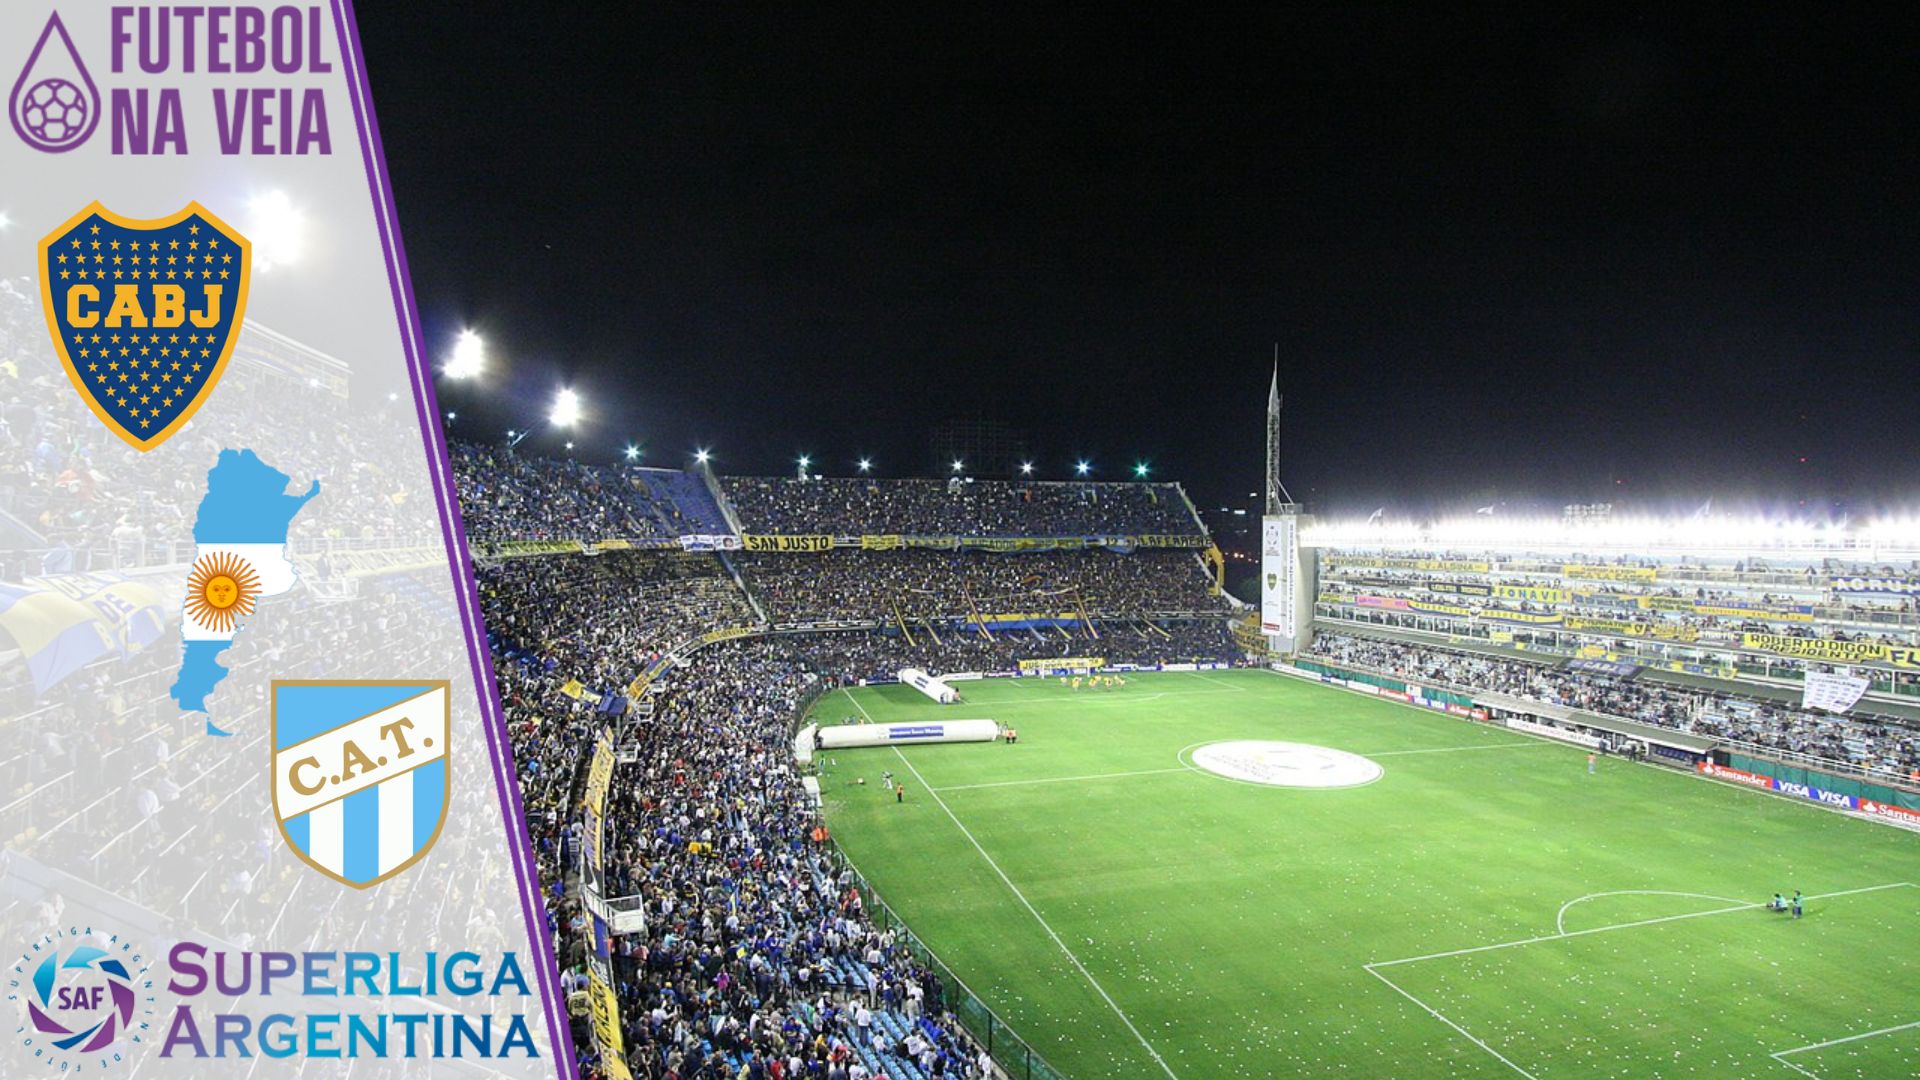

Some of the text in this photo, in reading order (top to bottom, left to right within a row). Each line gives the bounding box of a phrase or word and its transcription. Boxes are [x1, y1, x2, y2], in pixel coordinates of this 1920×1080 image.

[749, 537, 779, 550] SAN
[783, 536, 829, 550] JUSTO
[1750, 634, 1825, 648] ROBERTO
[1829, 641, 1880, 655] DIGON
[1714, 766, 1767, 787] Santander
[1778, 780, 1810, 797] VISA
[1817, 789, 1851, 808] VISA
